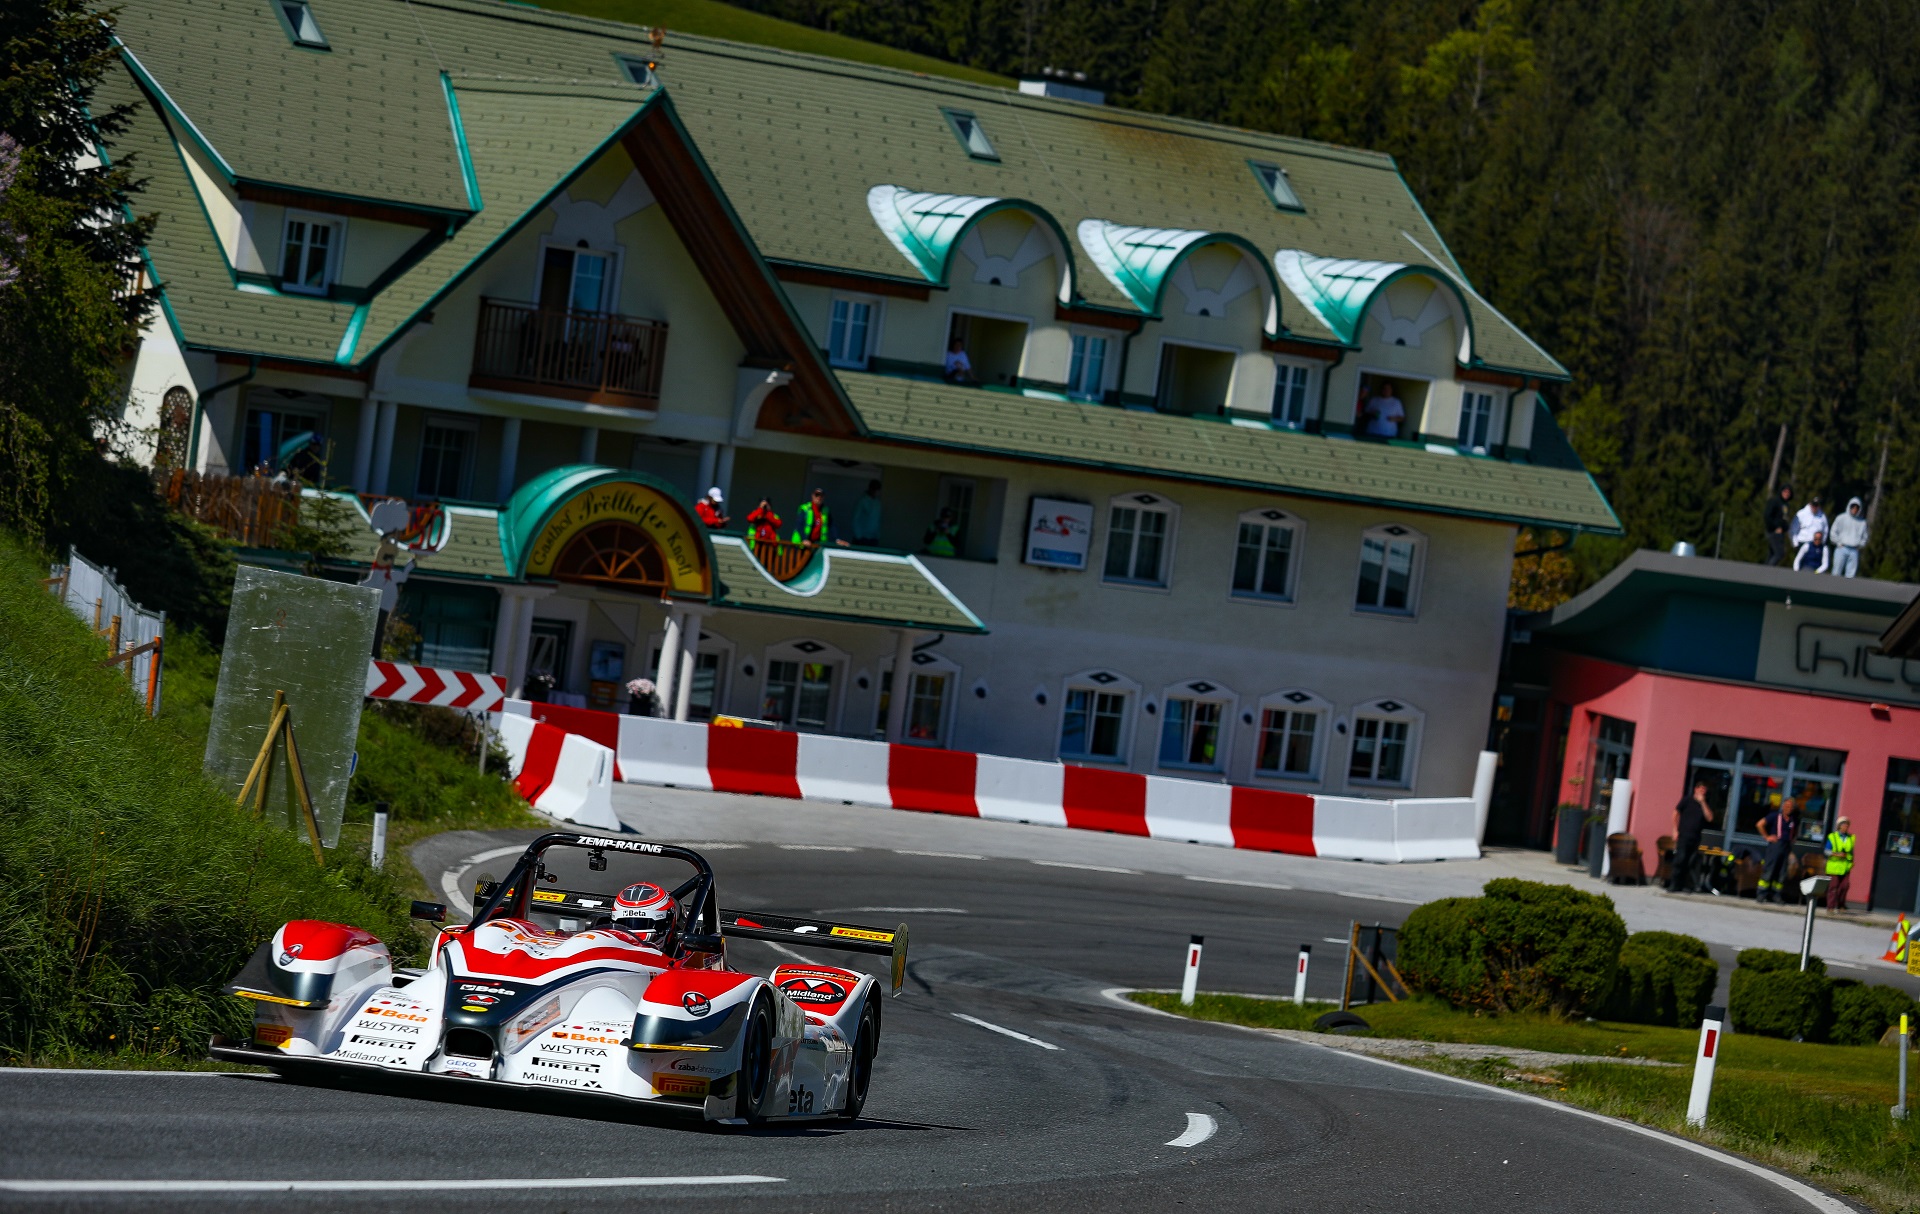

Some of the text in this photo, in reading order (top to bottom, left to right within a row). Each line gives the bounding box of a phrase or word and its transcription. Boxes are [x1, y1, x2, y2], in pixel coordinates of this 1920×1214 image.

[533, 510, 573, 566] Gasthof
[576, 835, 664, 853] ZEMP-RACING
[475, 986, 516, 996] Beta
[787, 990, 832, 1001] Midland
[380, 1009, 428, 1023] Beta
[356, 1020, 421, 1034] WISTRA
[350, 1034, 416, 1050] PIRELLI
[571, 1034, 619, 1045] Beta
[334, 1050, 387, 1063] Midland
[540, 1044, 608, 1057] WISTRA
[446, 1059, 477, 1067] GEKO
[532, 1057, 600, 1073] PIRELLI
[522, 1072, 578, 1086] Midland
[658, 1077, 706, 1094] PIRELLI
[789, 1084, 814, 1113] eta
